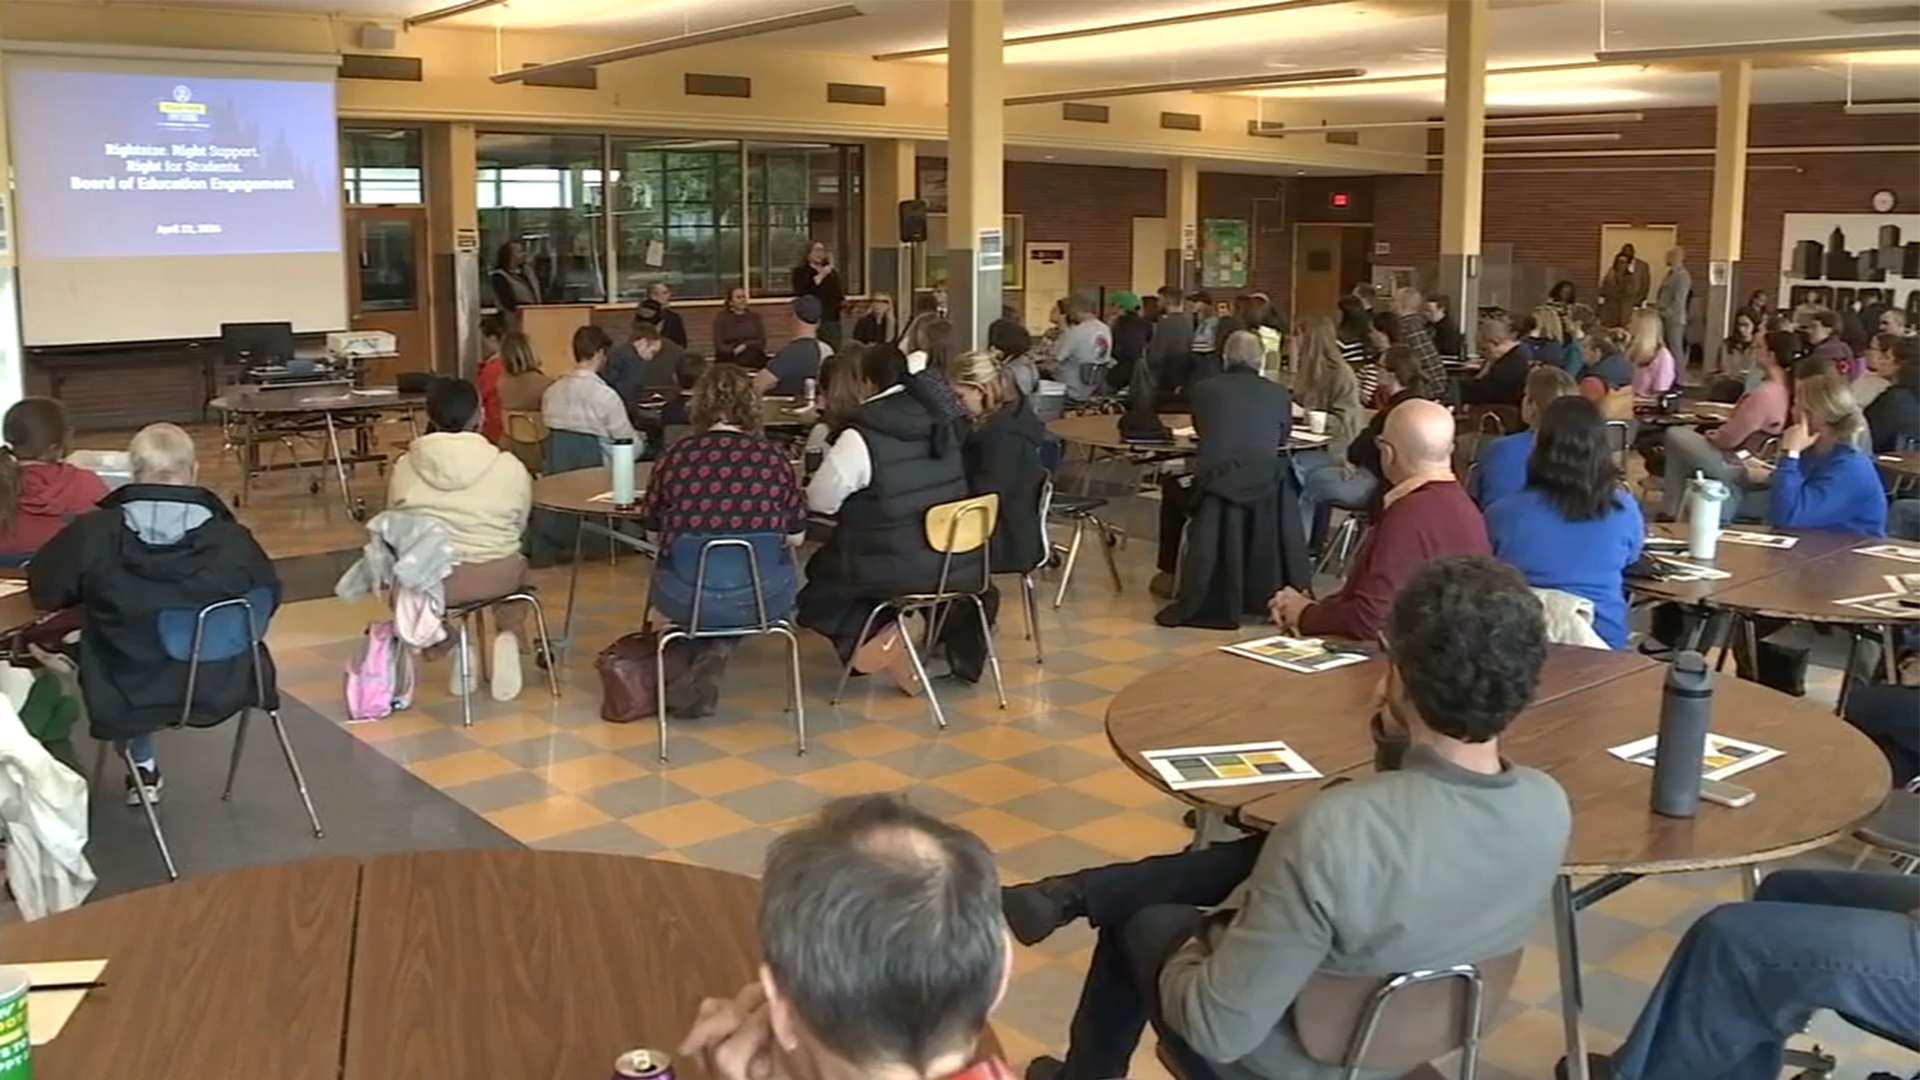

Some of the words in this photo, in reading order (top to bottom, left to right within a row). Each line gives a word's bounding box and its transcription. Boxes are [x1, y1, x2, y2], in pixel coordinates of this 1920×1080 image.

[171, 144, 207, 159] Right
[126, 160, 163, 175] Right
[164, 160, 183, 173] for
[70, 176, 115, 190] Board
[118, 176, 134, 190] of
[137, 177, 208, 191] Education
[210, 177, 295, 193] Engagement
[157, 224, 179, 236] April
